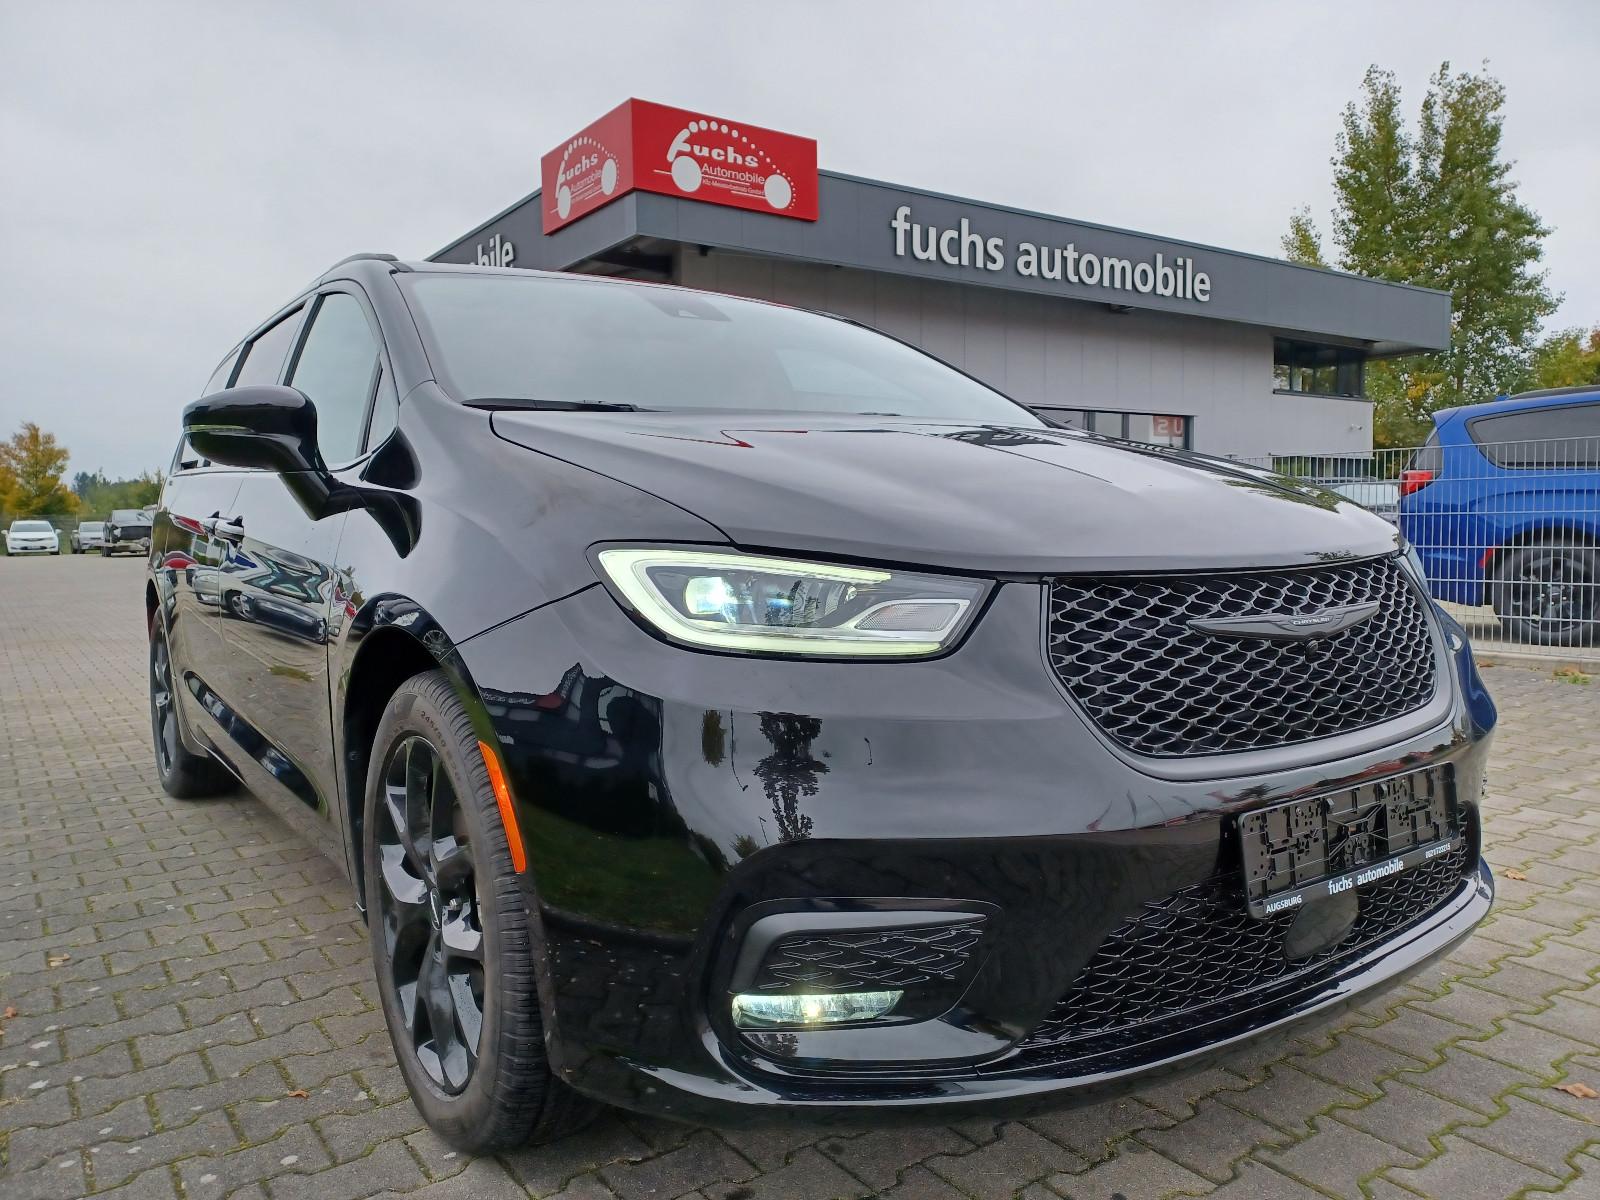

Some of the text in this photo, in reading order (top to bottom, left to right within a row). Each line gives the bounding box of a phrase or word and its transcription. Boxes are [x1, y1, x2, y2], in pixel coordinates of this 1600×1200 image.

[701, 163, 766, 185] Automobile
[891, 205, 1211, 302] fuchs automobile
[1265, 894, 1302, 914] AUGSBURG
[1328, 876, 1353, 895] fuchs
[1357, 859, 1404, 886] automobile
